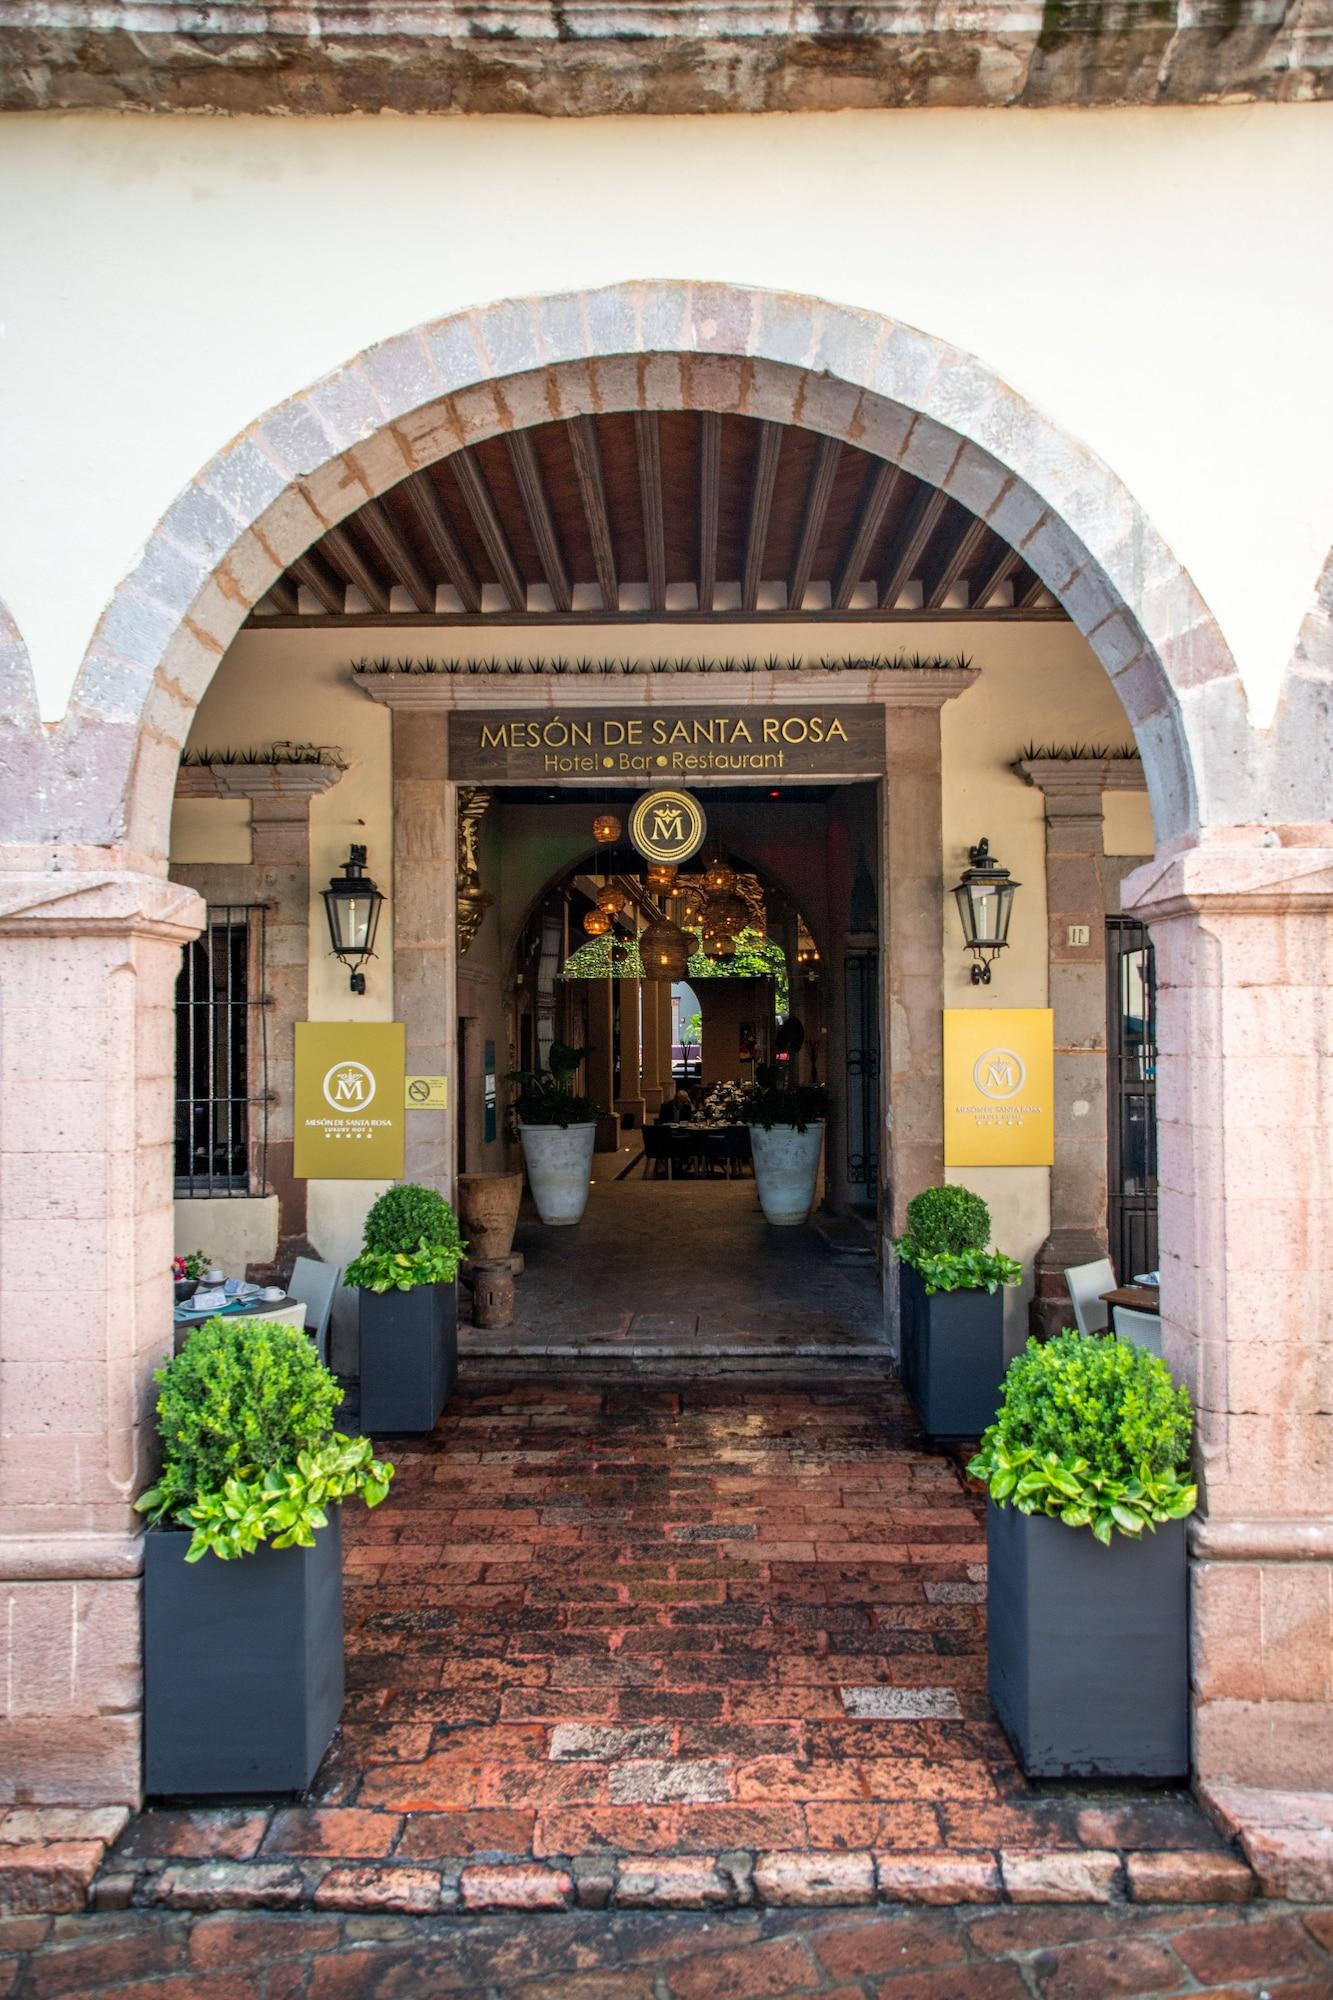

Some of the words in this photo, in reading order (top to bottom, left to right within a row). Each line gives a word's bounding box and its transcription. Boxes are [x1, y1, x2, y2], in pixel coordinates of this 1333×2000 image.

[480, 715, 592, 748] MESÓN
[603, 719, 643, 746] DE
[652, 718, 753, 745] SANTA
[763, 716, 849, 744] ROSA
[543, 752, 599, 772] Hotel
[619, 752, 652, 770] Bar
[672, 750, 784, 769] Restaurant
[650, 816, 685, 840] M
[335, 1079, 364, 1100] M
[334, 1119, 344, 1127] DE
[345, 1119, 370, 1127] SANTA
[370, 1119, 392, 1127] ROSA
